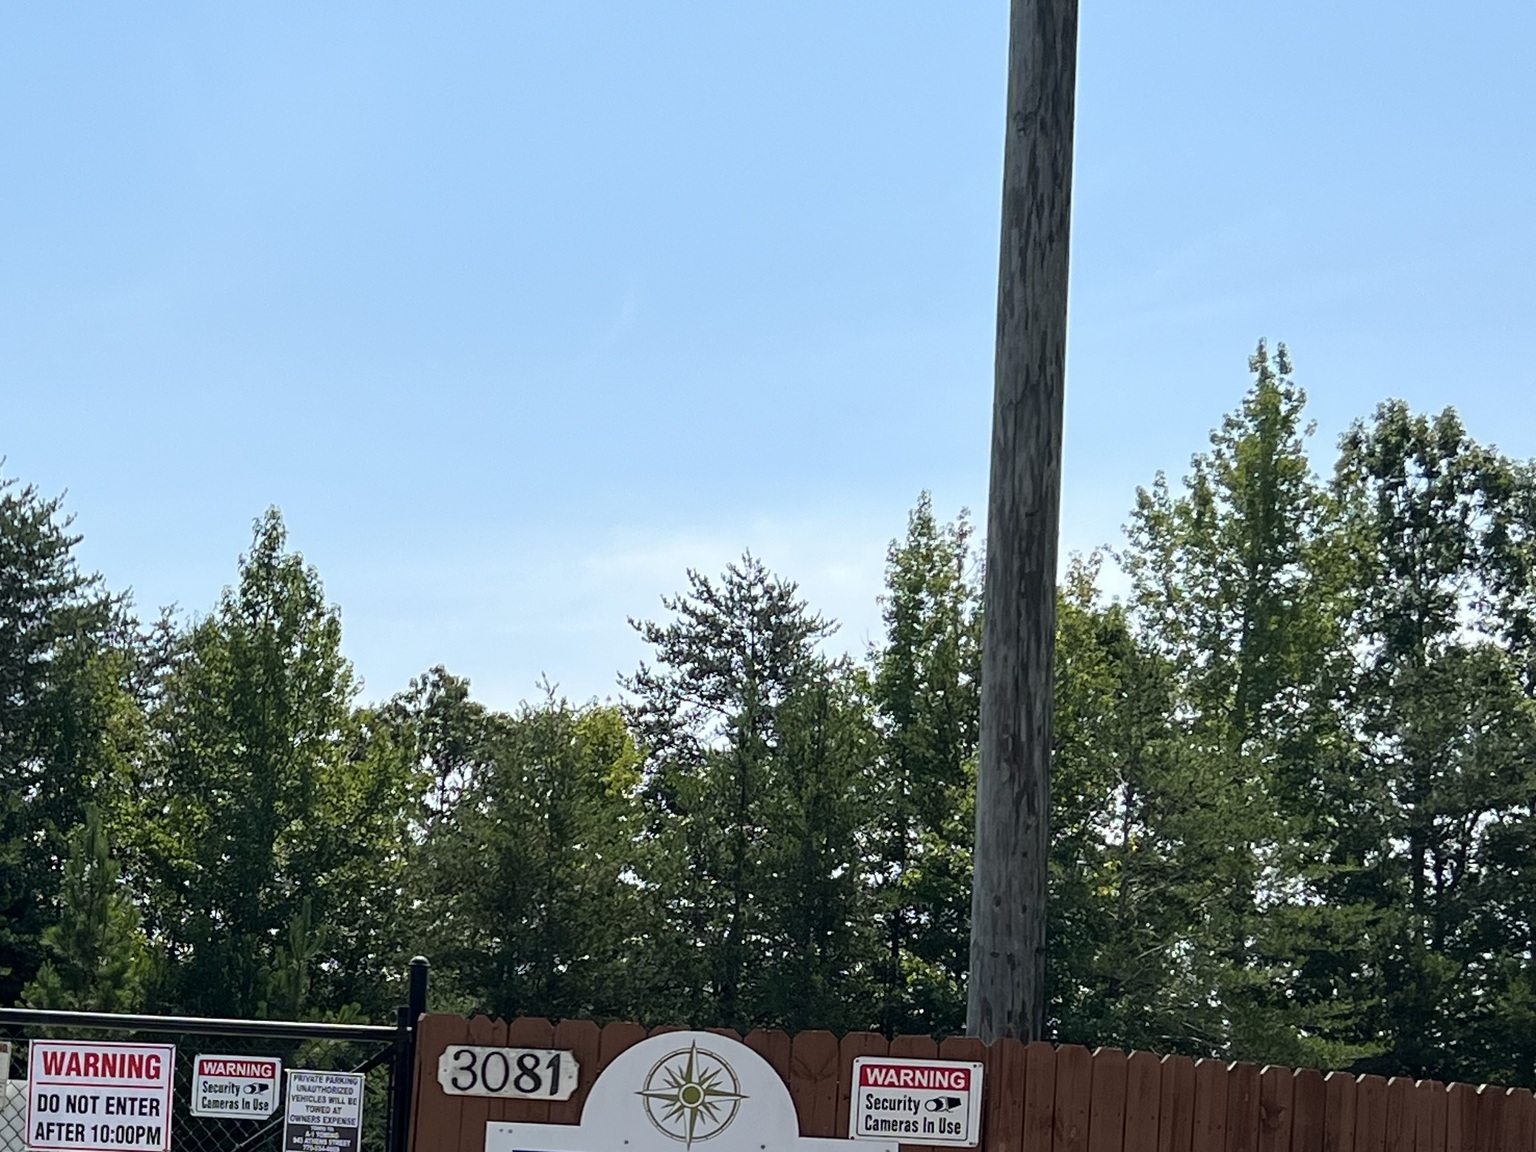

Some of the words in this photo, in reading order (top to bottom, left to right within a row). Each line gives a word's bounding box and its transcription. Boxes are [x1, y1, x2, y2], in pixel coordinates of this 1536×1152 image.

[42, 1051, 161, 1080] WARNING
[203, 1061, 272, 1077] WARNING
[451, 1049, 561, 1096] 3081
[294, 1074, 323, 1083] PRIVATE
[325, 1076, 358, 1086] PARKING
[866, 1068, 965, 1089] WARNING
[202, 1081, 240, 1097] Security
[296, 1084, 354, 1095] UNAUTHORIZED
[37, 1094, 60, 1113] DO
[66, 1095, 100, 1114] NOT
[105, 1096, 160, 1117] ENTER
[202, 1096, 239, 1110] Cameras
[242, 1098, 250, 1110] In
[253, 1098, 269, 1111] Use
[291, 1094, 327, 1103] VEHICLES
[328, 1096, 346, 1105] WILL
[347, 1098, 357, 1106] BE
[866, 1093, 920, 1115] Security
[305, 1105, 331, 1114] TOWED
[332, 1106, 342, 1114] AT
[290, 1114, 321, 1123] OWNERS
[322, 1116, 356, 1126] EXPENSE
[865, 1114, 919, 1133] Cameras
[922, 1116, 935, 1133] In
[938, 1117, 961, 1135] Use
[35, 1122, 85, 1142] AFTER
[91, 1124, 161, 1145] 10:00PM
